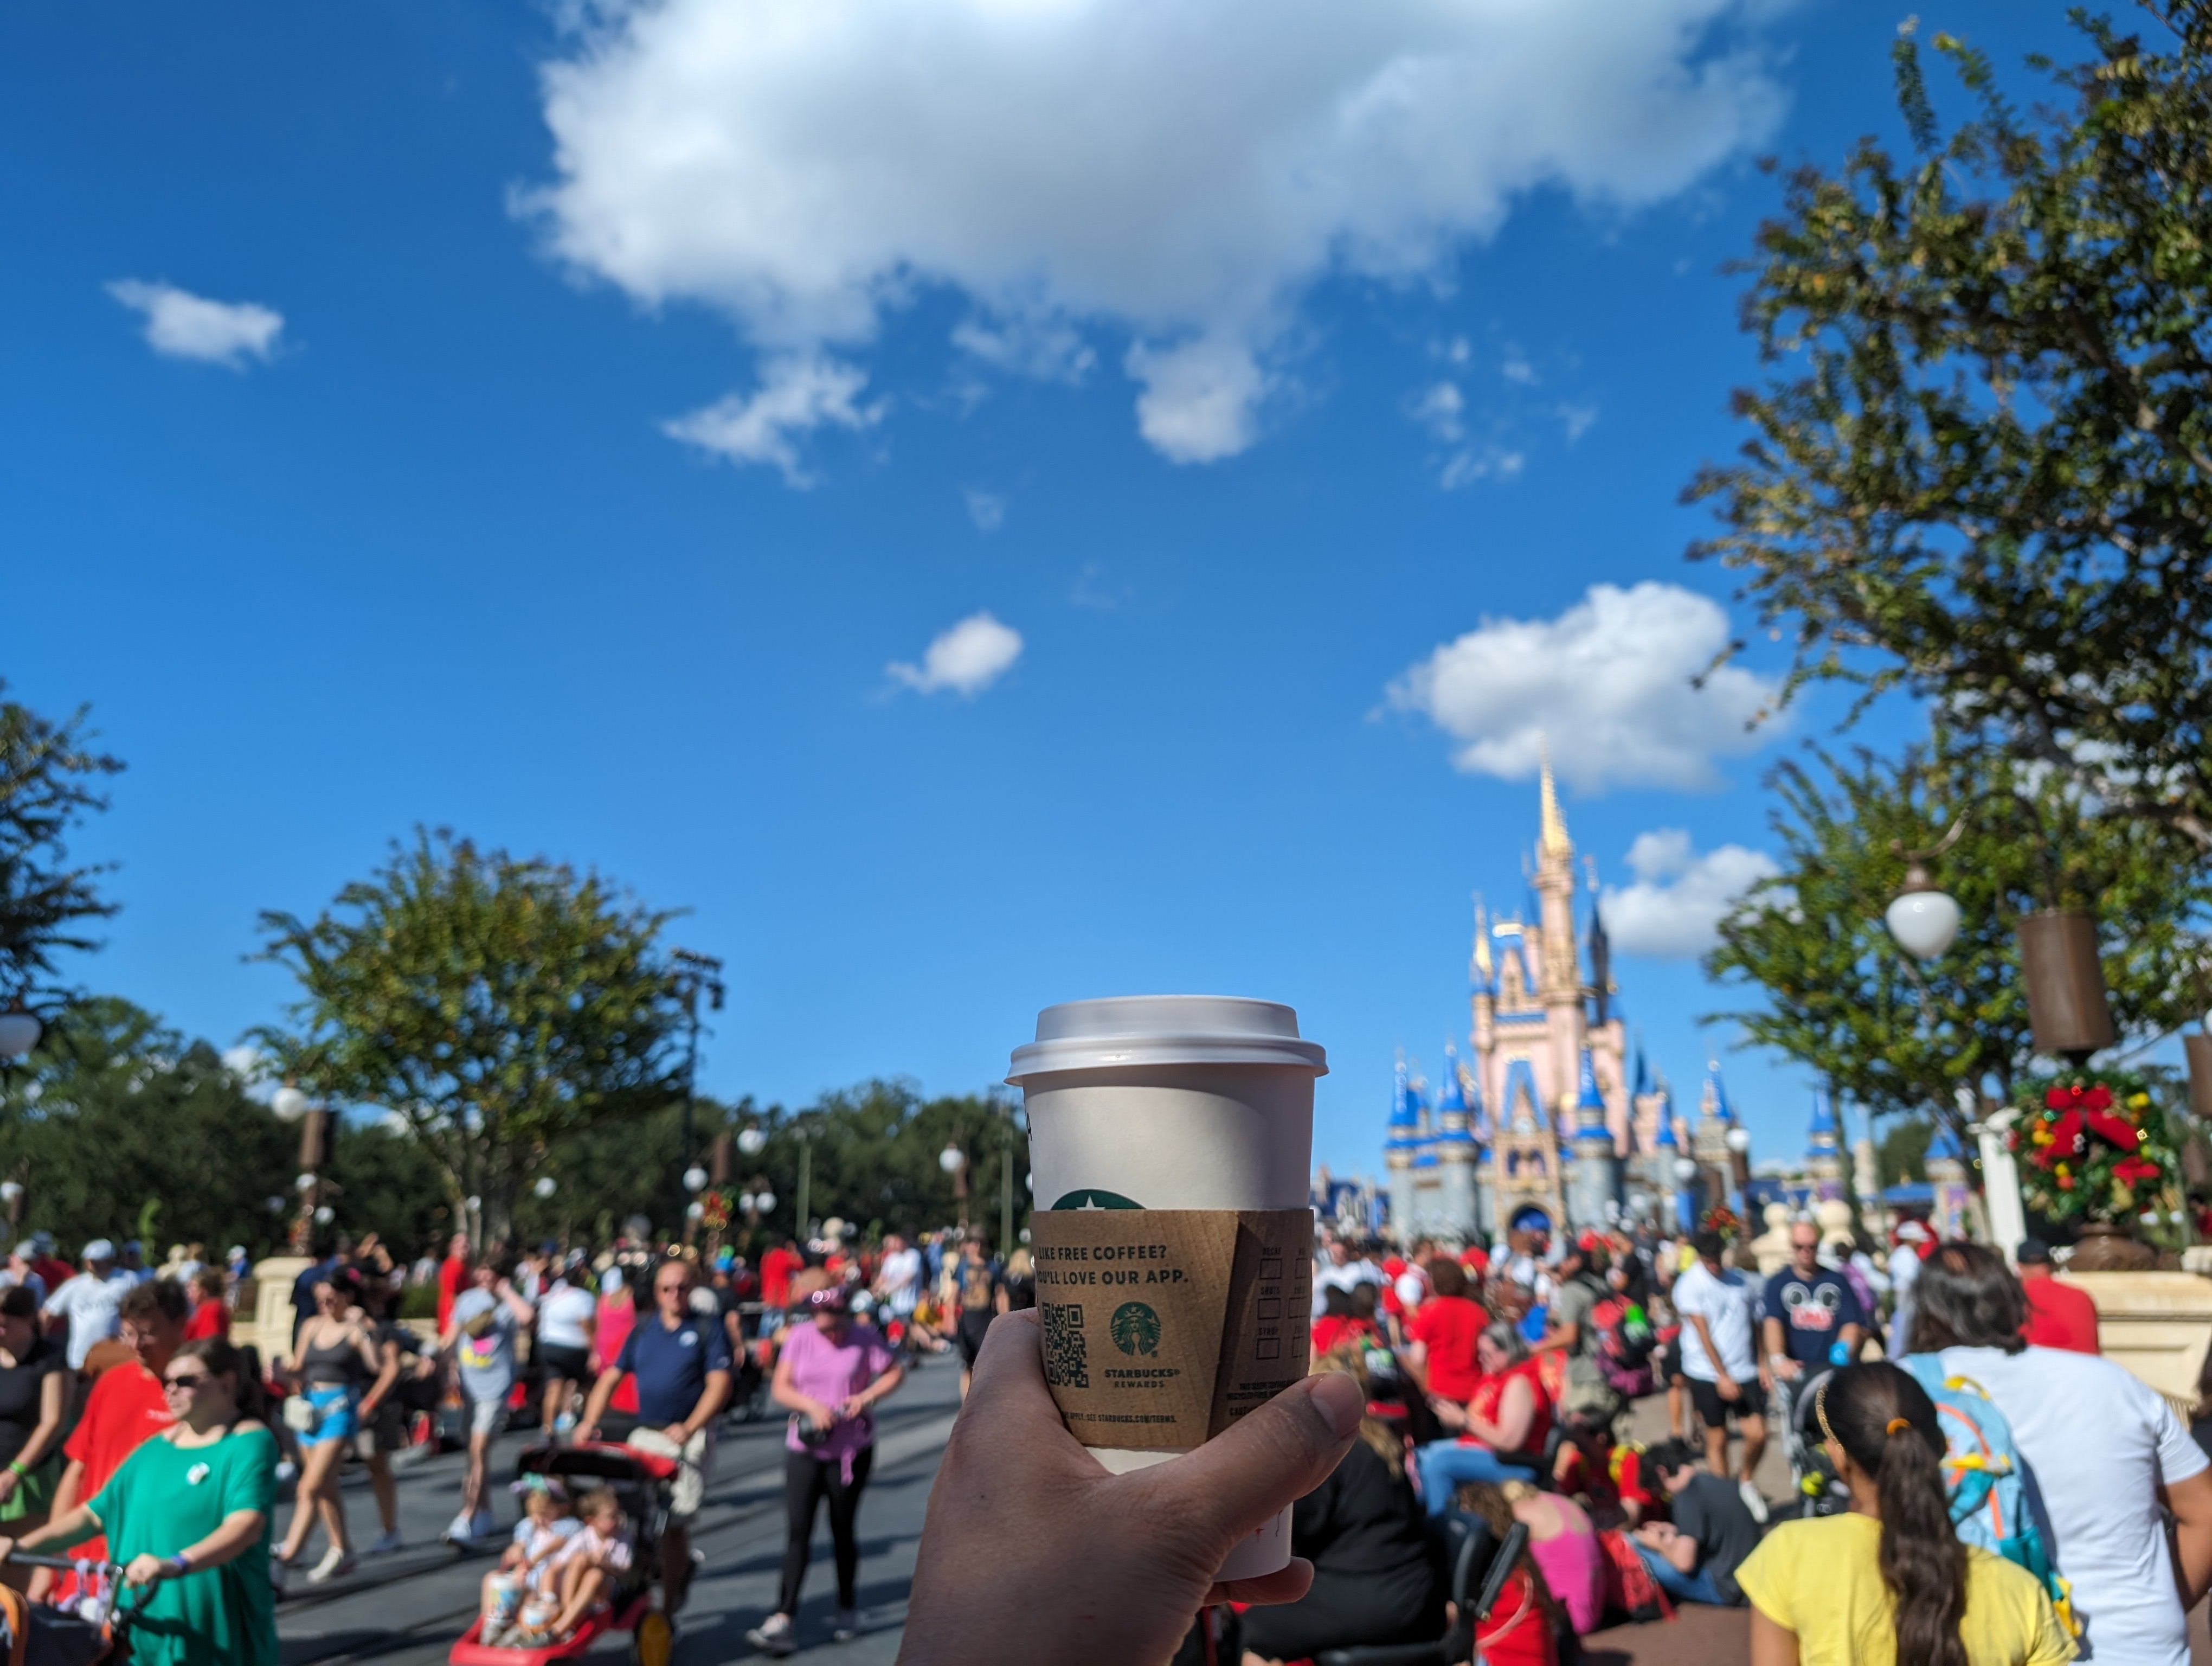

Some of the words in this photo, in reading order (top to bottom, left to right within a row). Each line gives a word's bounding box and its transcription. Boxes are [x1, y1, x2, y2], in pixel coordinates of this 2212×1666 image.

[1039, 1246, 1055, 1260] LIKE
[1058, 1246, 1088, 1260] FREE
[1093, 1245, 1167, 1260] COFFEE?
[1063, 1271, 1096, 1285] LOVE
[1102, 1271, 1139, 1285] OUR
[1146, 1269, 1189, 1284] APP.
[1114, 1380, 1165, 1388] REWARDS
